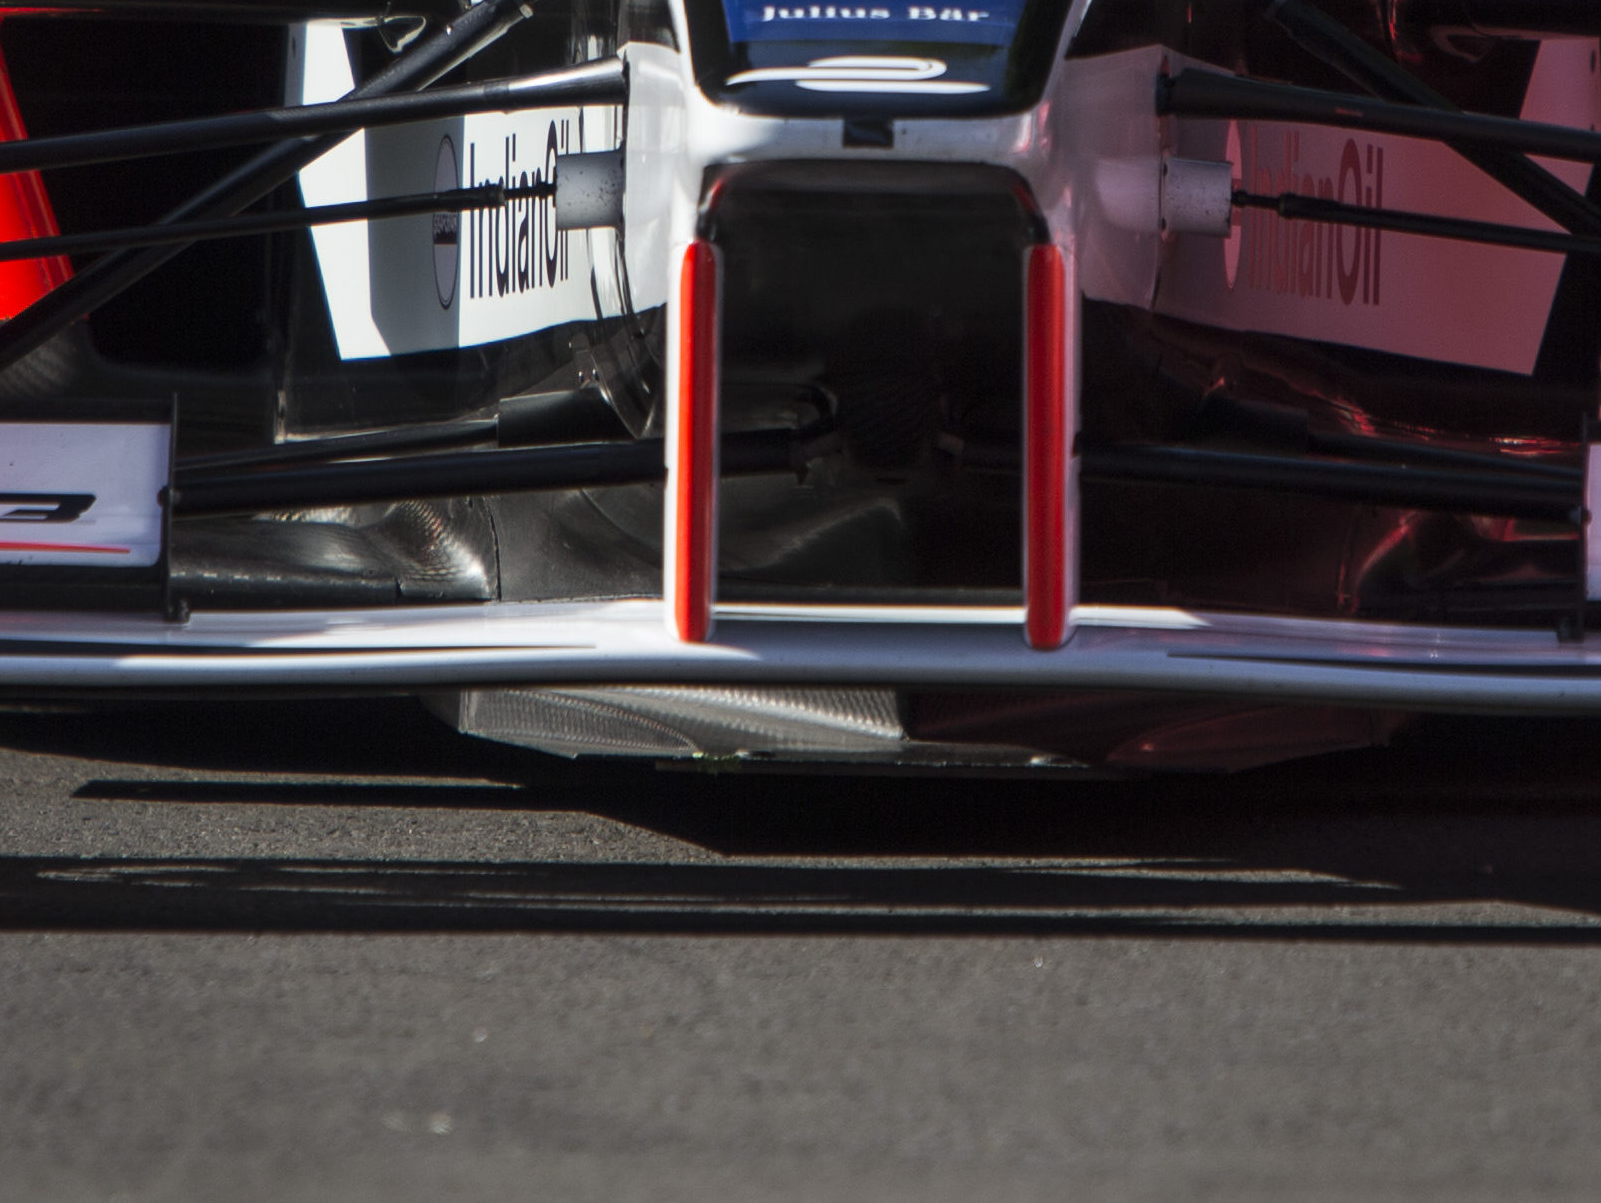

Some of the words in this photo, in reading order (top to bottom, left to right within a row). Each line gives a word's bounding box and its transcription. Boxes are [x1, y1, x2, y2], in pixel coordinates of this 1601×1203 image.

[762, 5, 891, 23] Julius
[908, 6, 990, 23] Bär
[470, 119, 569, 299] IndianOil
[1249, 125, 1384, 306] IndianOil
